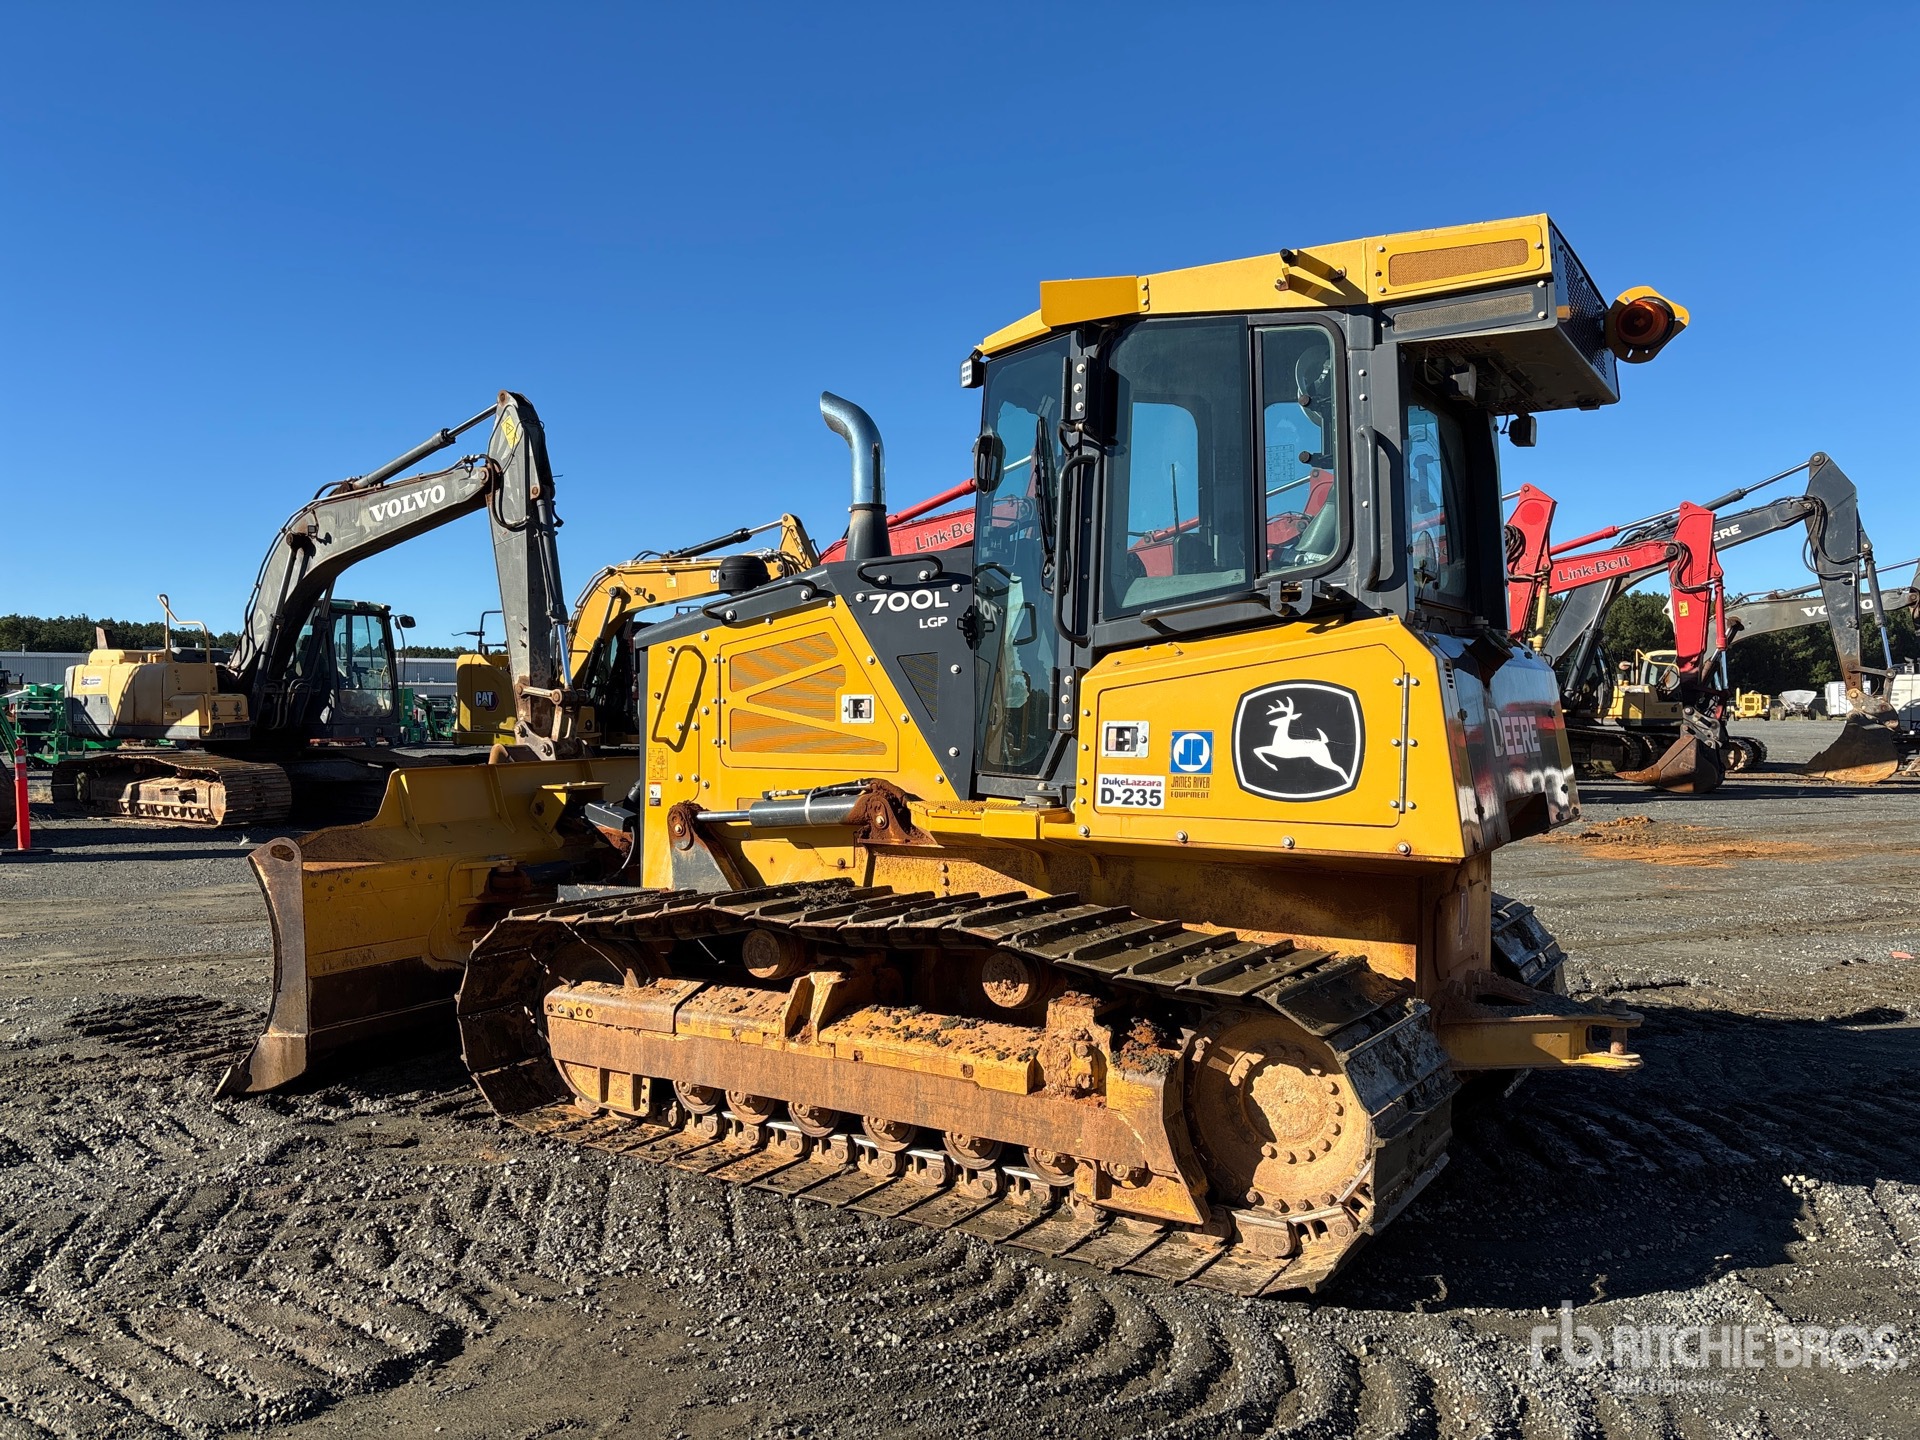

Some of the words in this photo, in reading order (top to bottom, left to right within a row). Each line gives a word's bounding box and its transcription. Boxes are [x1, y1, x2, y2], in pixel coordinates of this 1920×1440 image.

[369, 485, 446, 522] VOLVO
[916, 522, 974, 550] Link-Be
[1713, 524, 1741, 541] ERE
[1558, 555, 1631, 582] Link-Belt
[869, 590, 949, 614] 700L
[919, 616, 948, 628] LGP
[475, 691, 493, 707] CAT
[1488, 708, 1540, 757] DEERE
[1102, 777, 1162, 787] DukeLazzara
[1171, 776, 1191, 788] JAMES
[1193, 777, 1210, 789] RIVER
[1100, 788, 1161, 806] D-235
